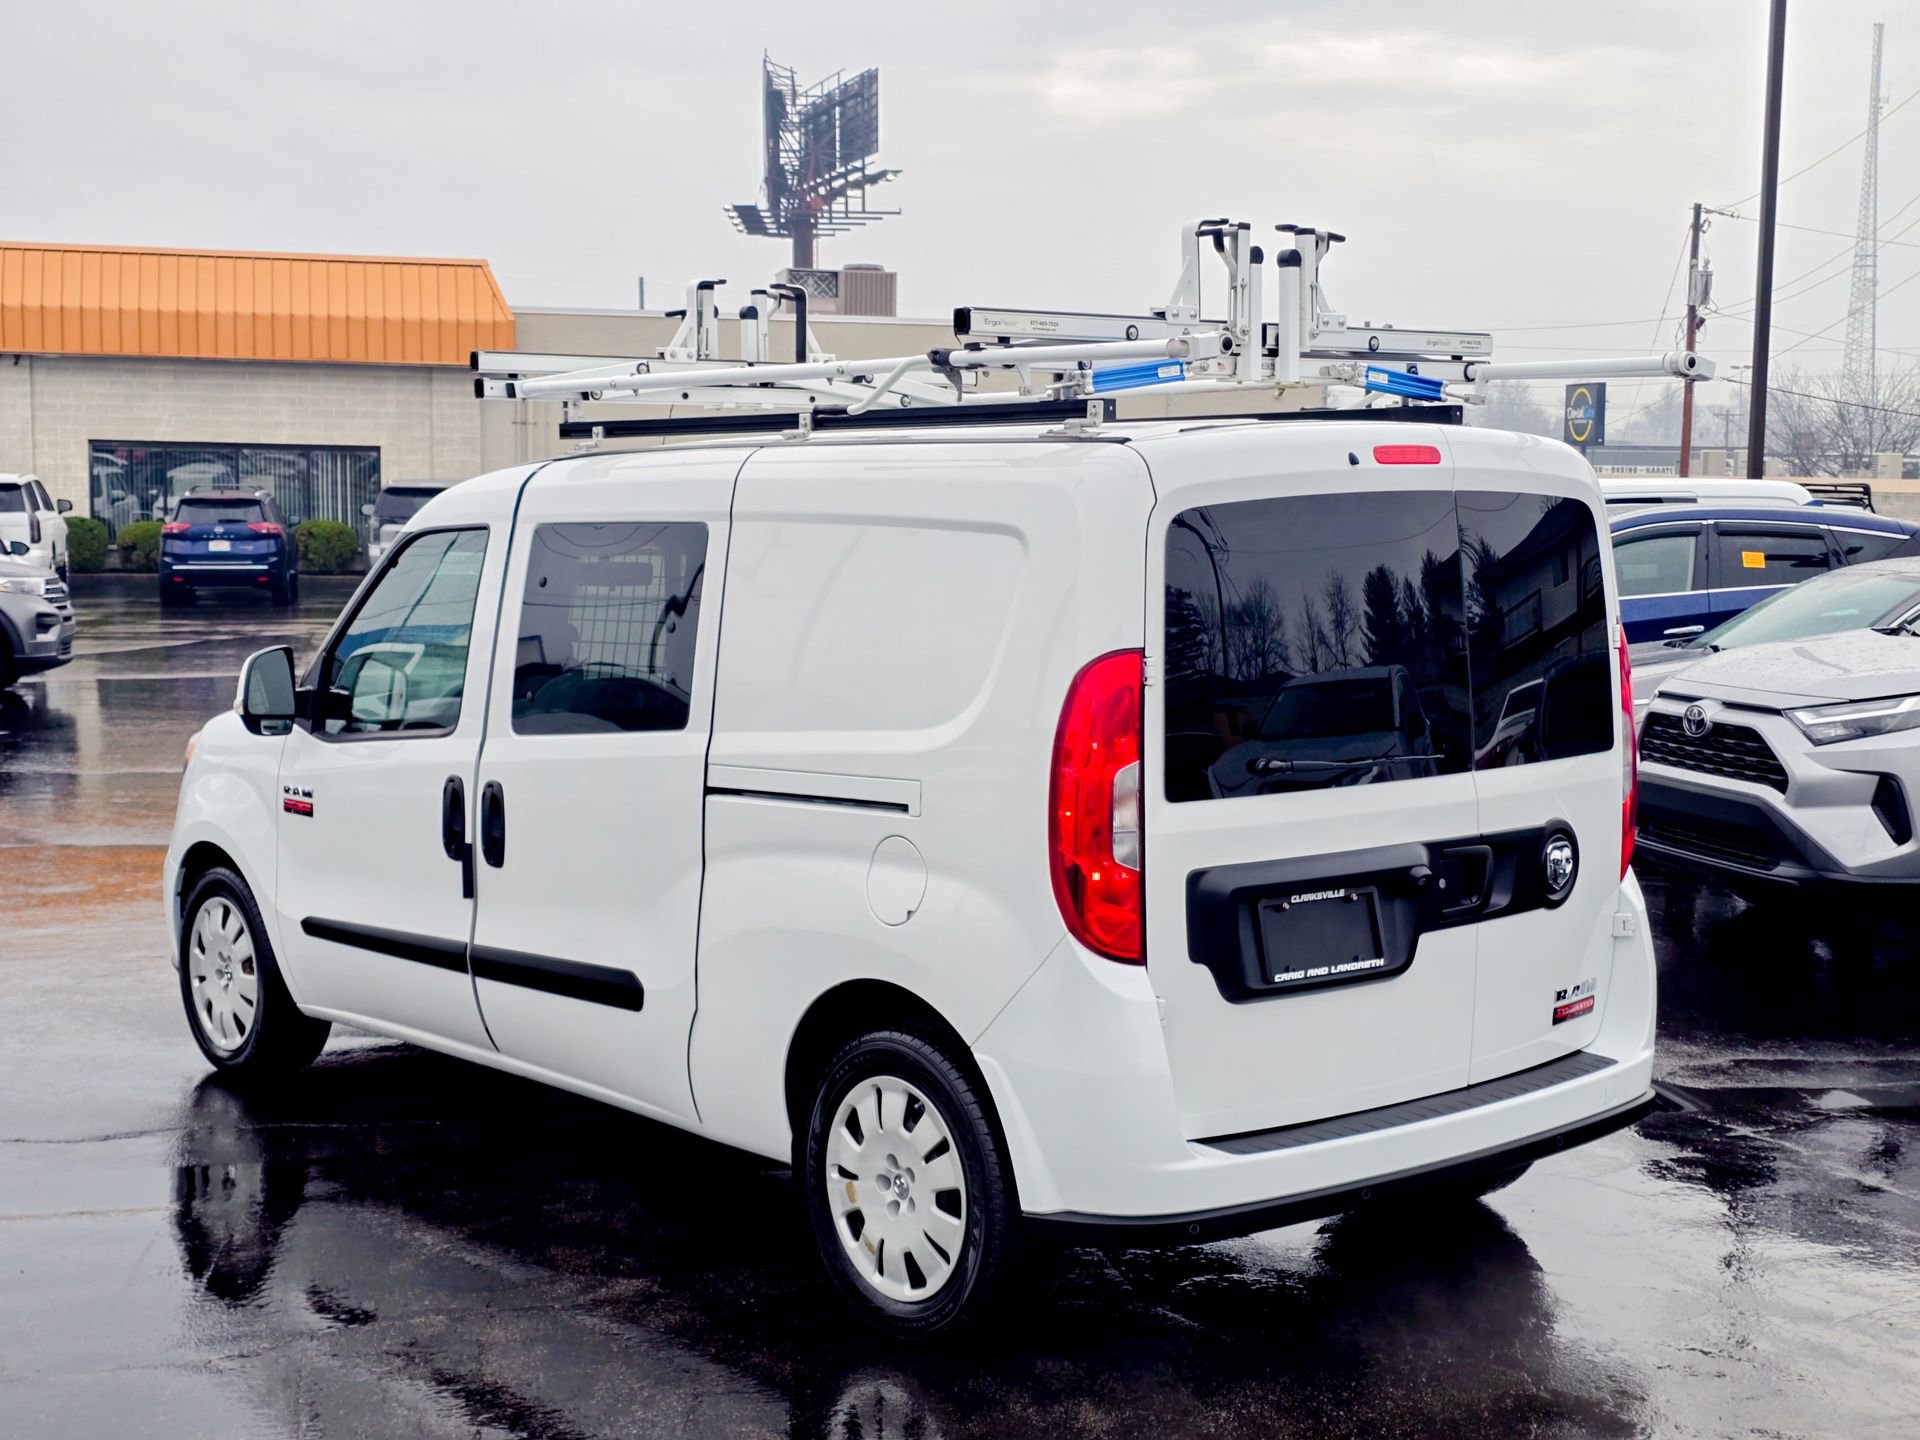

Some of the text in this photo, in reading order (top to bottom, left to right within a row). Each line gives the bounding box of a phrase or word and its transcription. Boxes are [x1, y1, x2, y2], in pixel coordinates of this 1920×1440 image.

[1291, 889, 1345, 903] CLARKSVILLE
[1274, 958, 1384, 983] CRAIG AND LANDRETH
